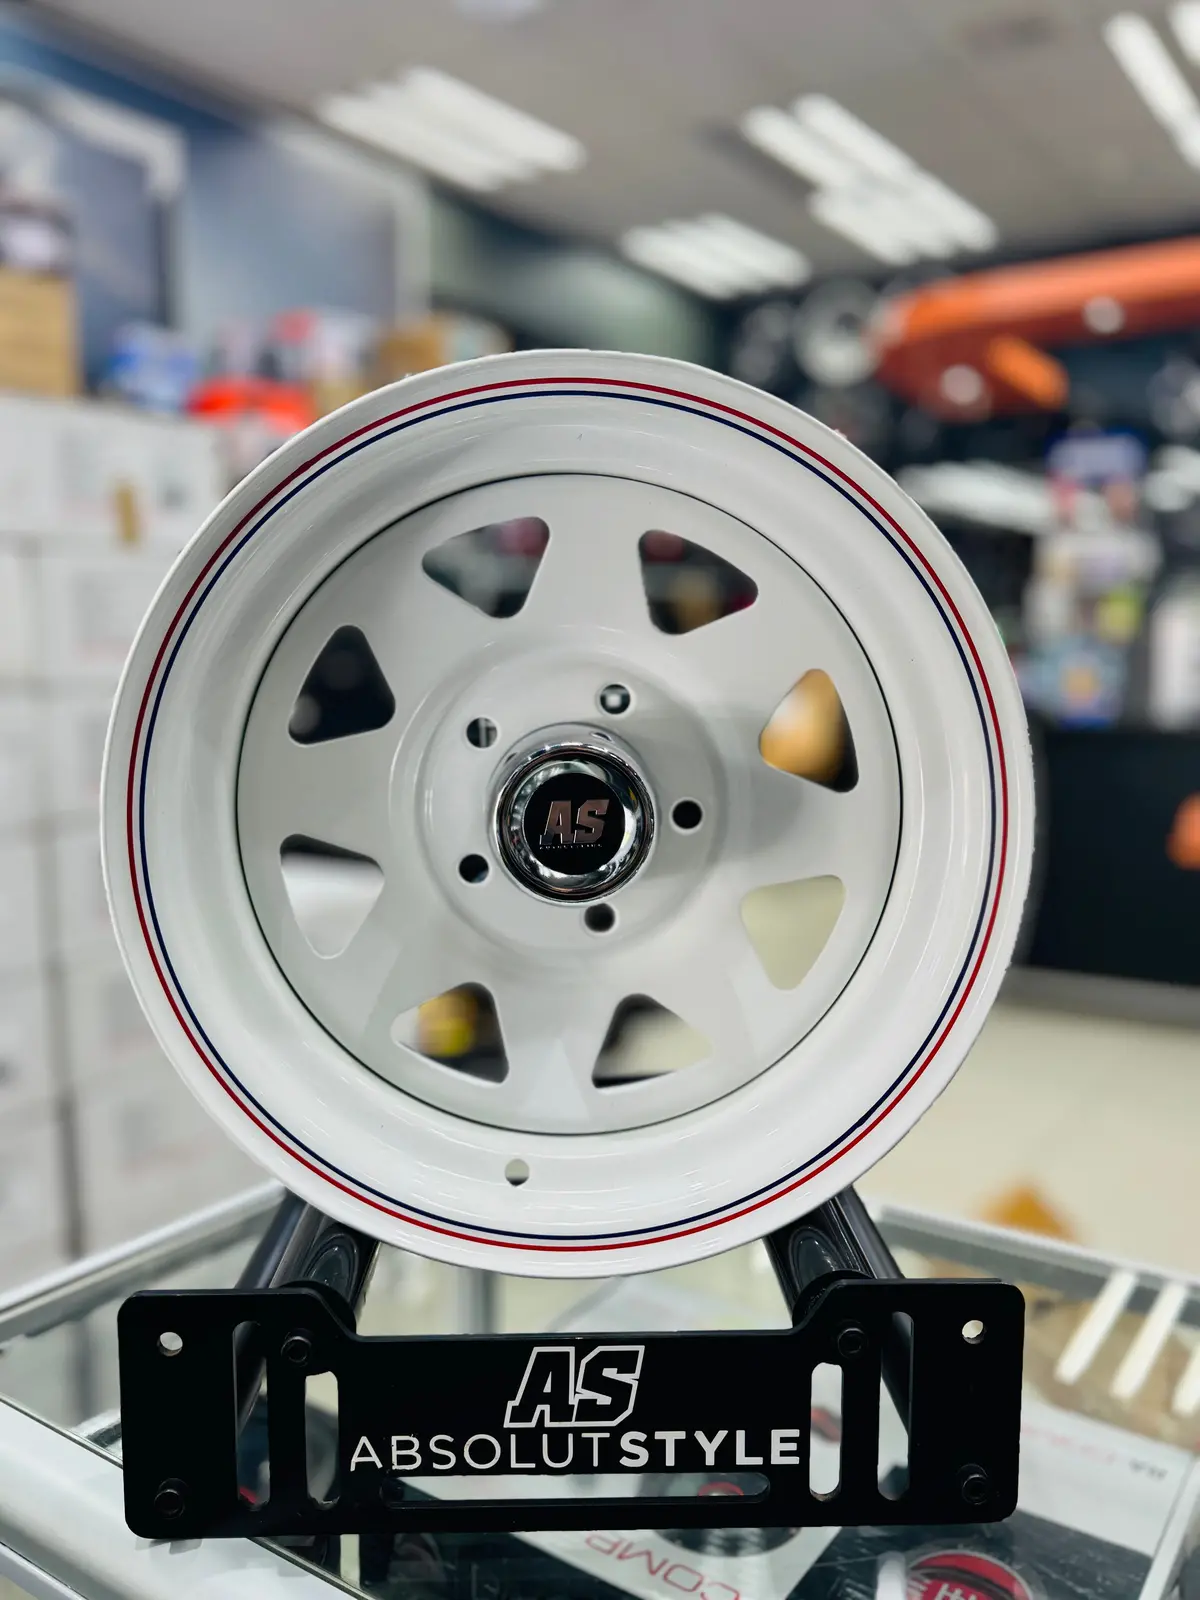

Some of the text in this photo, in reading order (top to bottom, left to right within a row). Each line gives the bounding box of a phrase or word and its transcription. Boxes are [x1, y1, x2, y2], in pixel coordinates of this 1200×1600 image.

[539, 799, 610, 846] AS
[503, 1345, 645, 1428] AS
[349, 1428, 800, 1472] ABSOLUTSTYLE
